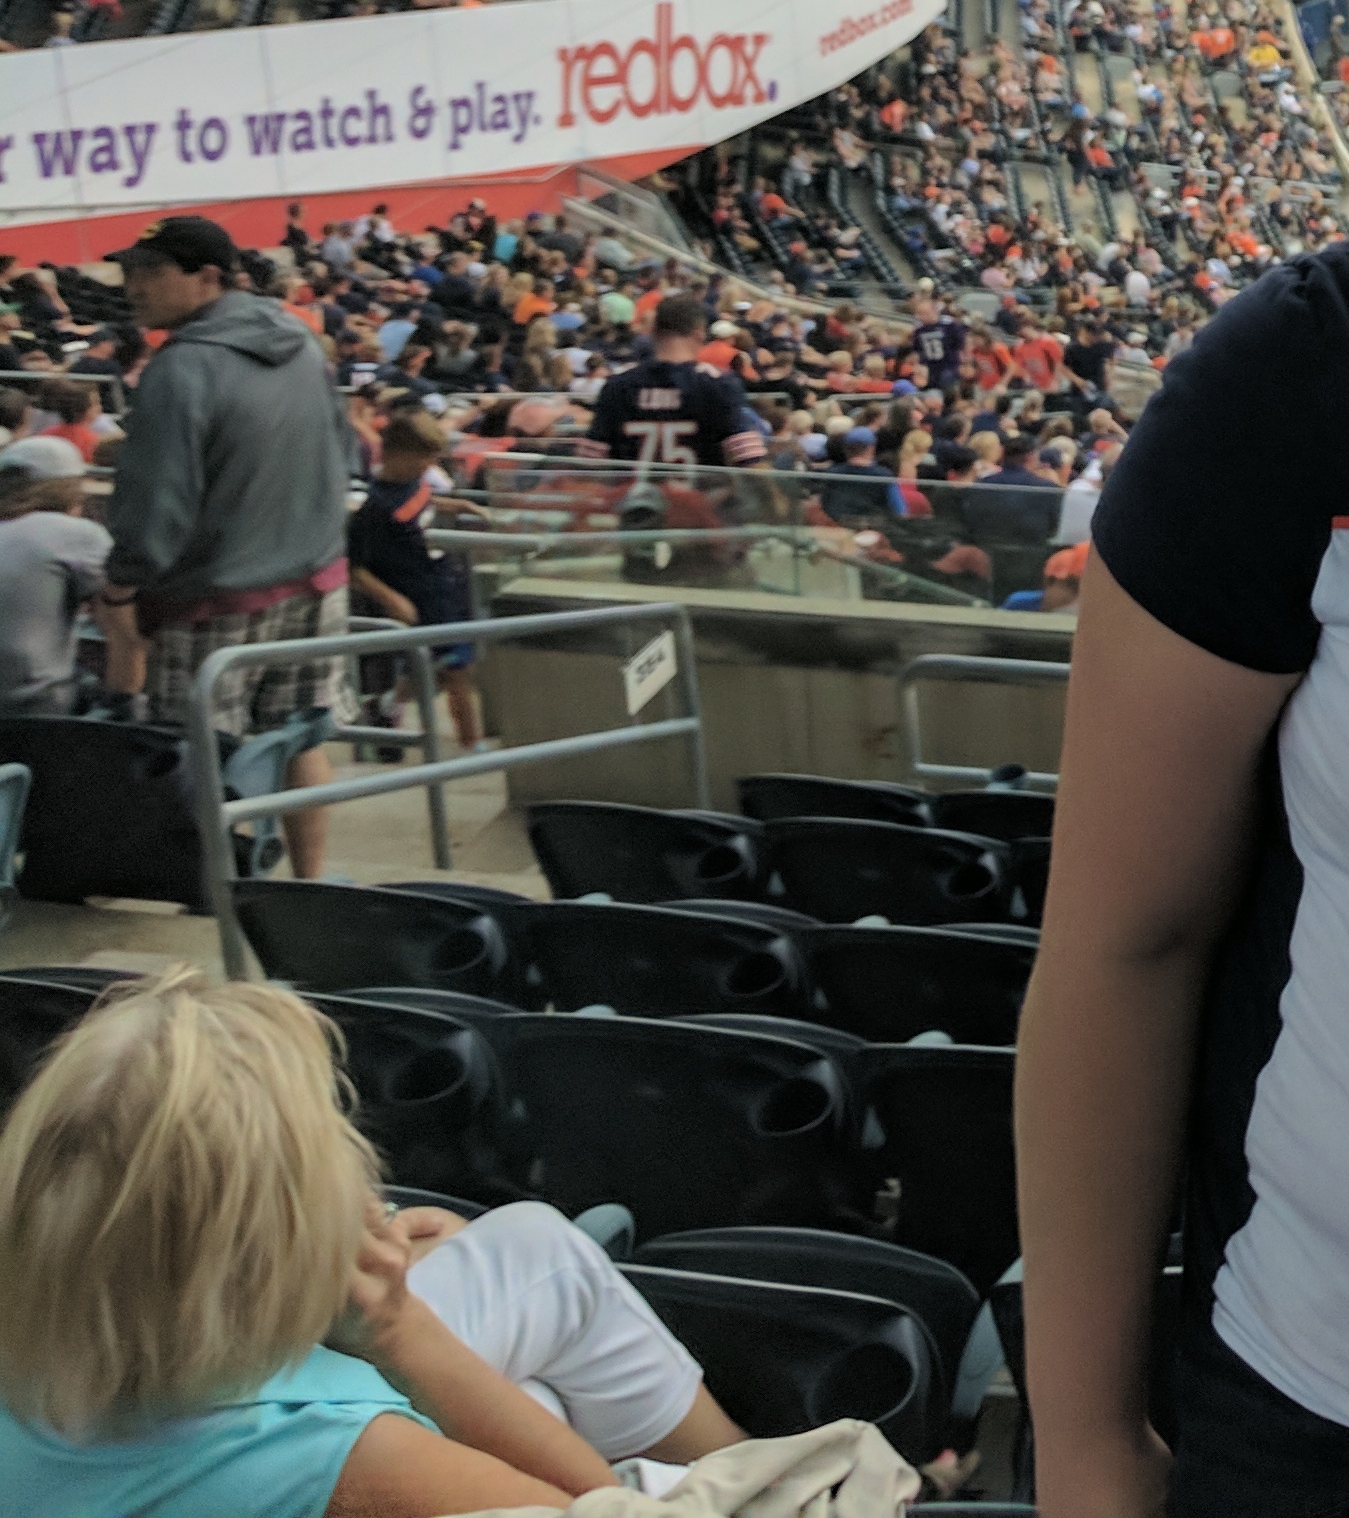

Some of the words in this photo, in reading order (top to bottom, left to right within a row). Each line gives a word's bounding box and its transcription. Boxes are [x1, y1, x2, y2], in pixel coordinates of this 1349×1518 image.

[33, 120, 158, 188] way
[175, 107, 229, 163] to
[244, 88, 395, 157] watch
[407, 83, 436, 140] &
[447, 81, 542, 151] play.
[624, 420, 700, 482] 75
